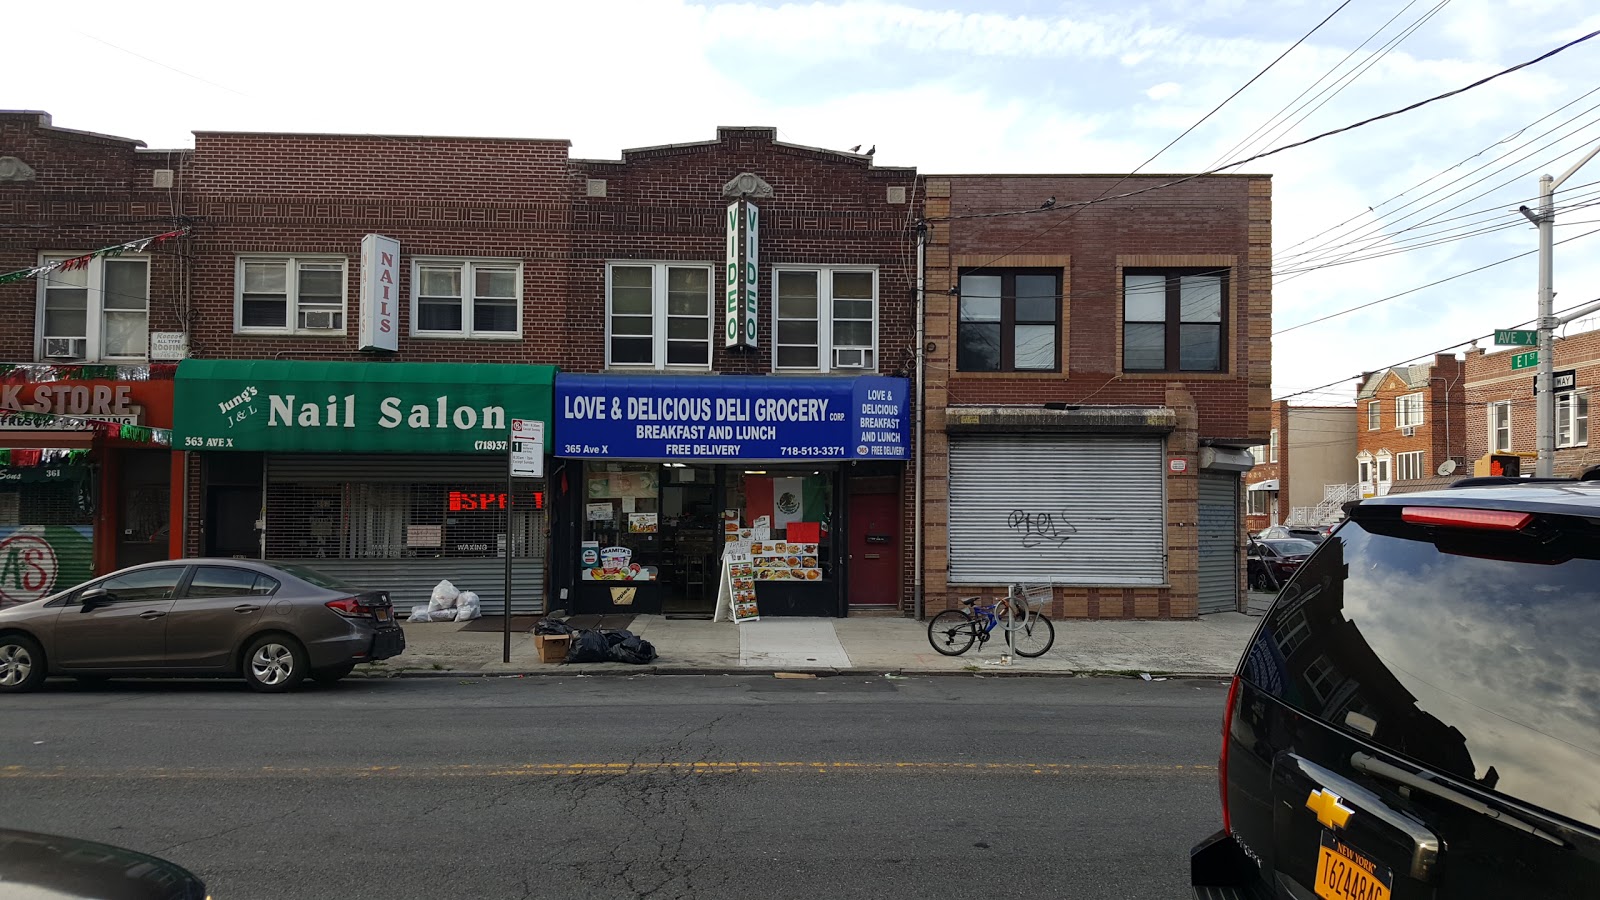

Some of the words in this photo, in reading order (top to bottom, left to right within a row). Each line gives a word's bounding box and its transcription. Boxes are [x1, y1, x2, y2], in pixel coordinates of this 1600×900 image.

[727, 207, 738, 341] VIDEO
[747, 207, 757, 341] VIDEO
[380, 251, 394, 334] NAILS
[1498, 332, 1518, 344] AVE
[1526, 332, 1532, 344] X
[1518, 356, 1522, 368] E
[1556, 376, 1570, 386] WAY
[34, 385, 131, 414] STORE
[218, 386, 259, 414] Jung's
[868, 390, 886, 400] LOVE
[888, 390, 892, 400] &
[267, 393, 356, 427] Nail
[377, 395, 506, 430] Salon
[564, 395, 606, 420] LOVE
[610, 396, 623, 420] &
[627, 396, 712, 421] DELICIOUS
[716, 398, 750, 421] DELI
[754, 398, 829, 422] GROCERY
[830, 412, 846, 422] CORP.
[862, 404, 898, 416] DELICIOUS
[228, 416, 234, 428] J
[236, 410, 246, 422] &
[248, 404, 256, 414] L
[860, 418, 900, 428] BREAKFAST
[636, 424, 706, 440] BREAKFAST
[708, 425, 733, 440] AND
[736, 425, 776, 440] LUNCH
[860, 432, 876, 442] AND
[878, 432, 900, 442] LUNCH
[184, 438, 202, 446] 363
[206, 438, 224, 446] AVE
[226, 438, 234, 446] X
[474, 440, 508, 450] (718)37
[564, 444, 580, 454] 365
[584, 446, 600, 454] Ave
[602, 446, 608, 454] X
[666, 444, 690, 454] FREE
[694, 444, 740, 454] DELIVERY
[780, 446, 844, 454] 718-513-3371
[872, 446, 882, 454] FREE
[884, 446, 904, 454] DELIVERY
[46, 470, 60, 478] 361
[1337, 841, 1355, 860] NEW
[1355, 852, 1376, 874] YORK
